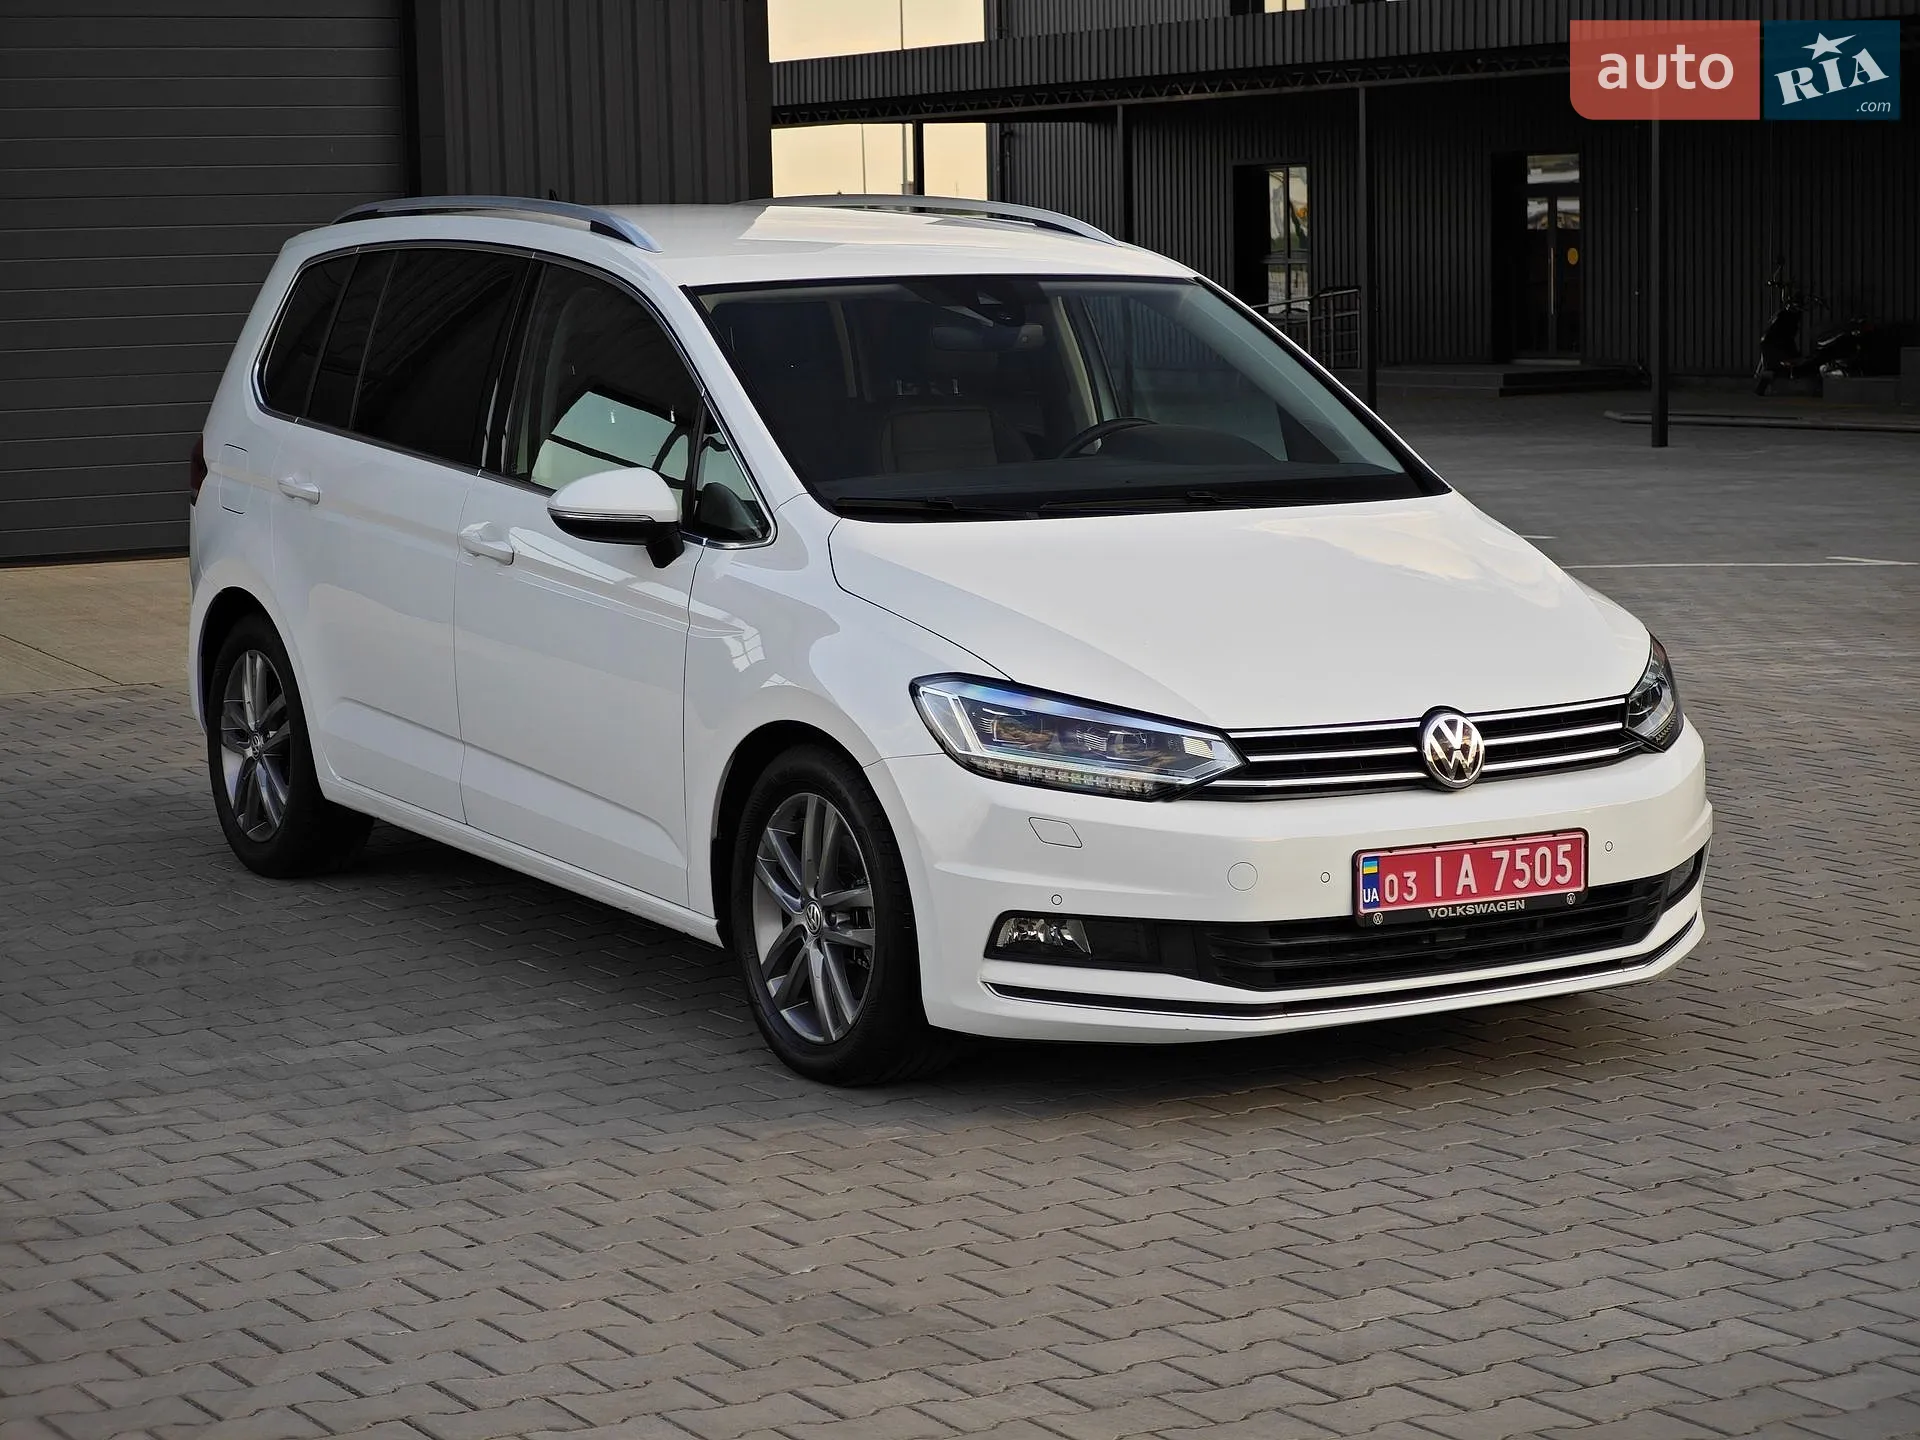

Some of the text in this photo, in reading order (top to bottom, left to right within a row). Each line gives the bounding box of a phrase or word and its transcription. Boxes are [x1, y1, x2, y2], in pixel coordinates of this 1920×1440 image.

[1384, 844, 1574, 903] 03 IA 7505
[1363, 887, 1380, 903] UA
[1428, 899, 1526, 919] VOLKSWAGEN
